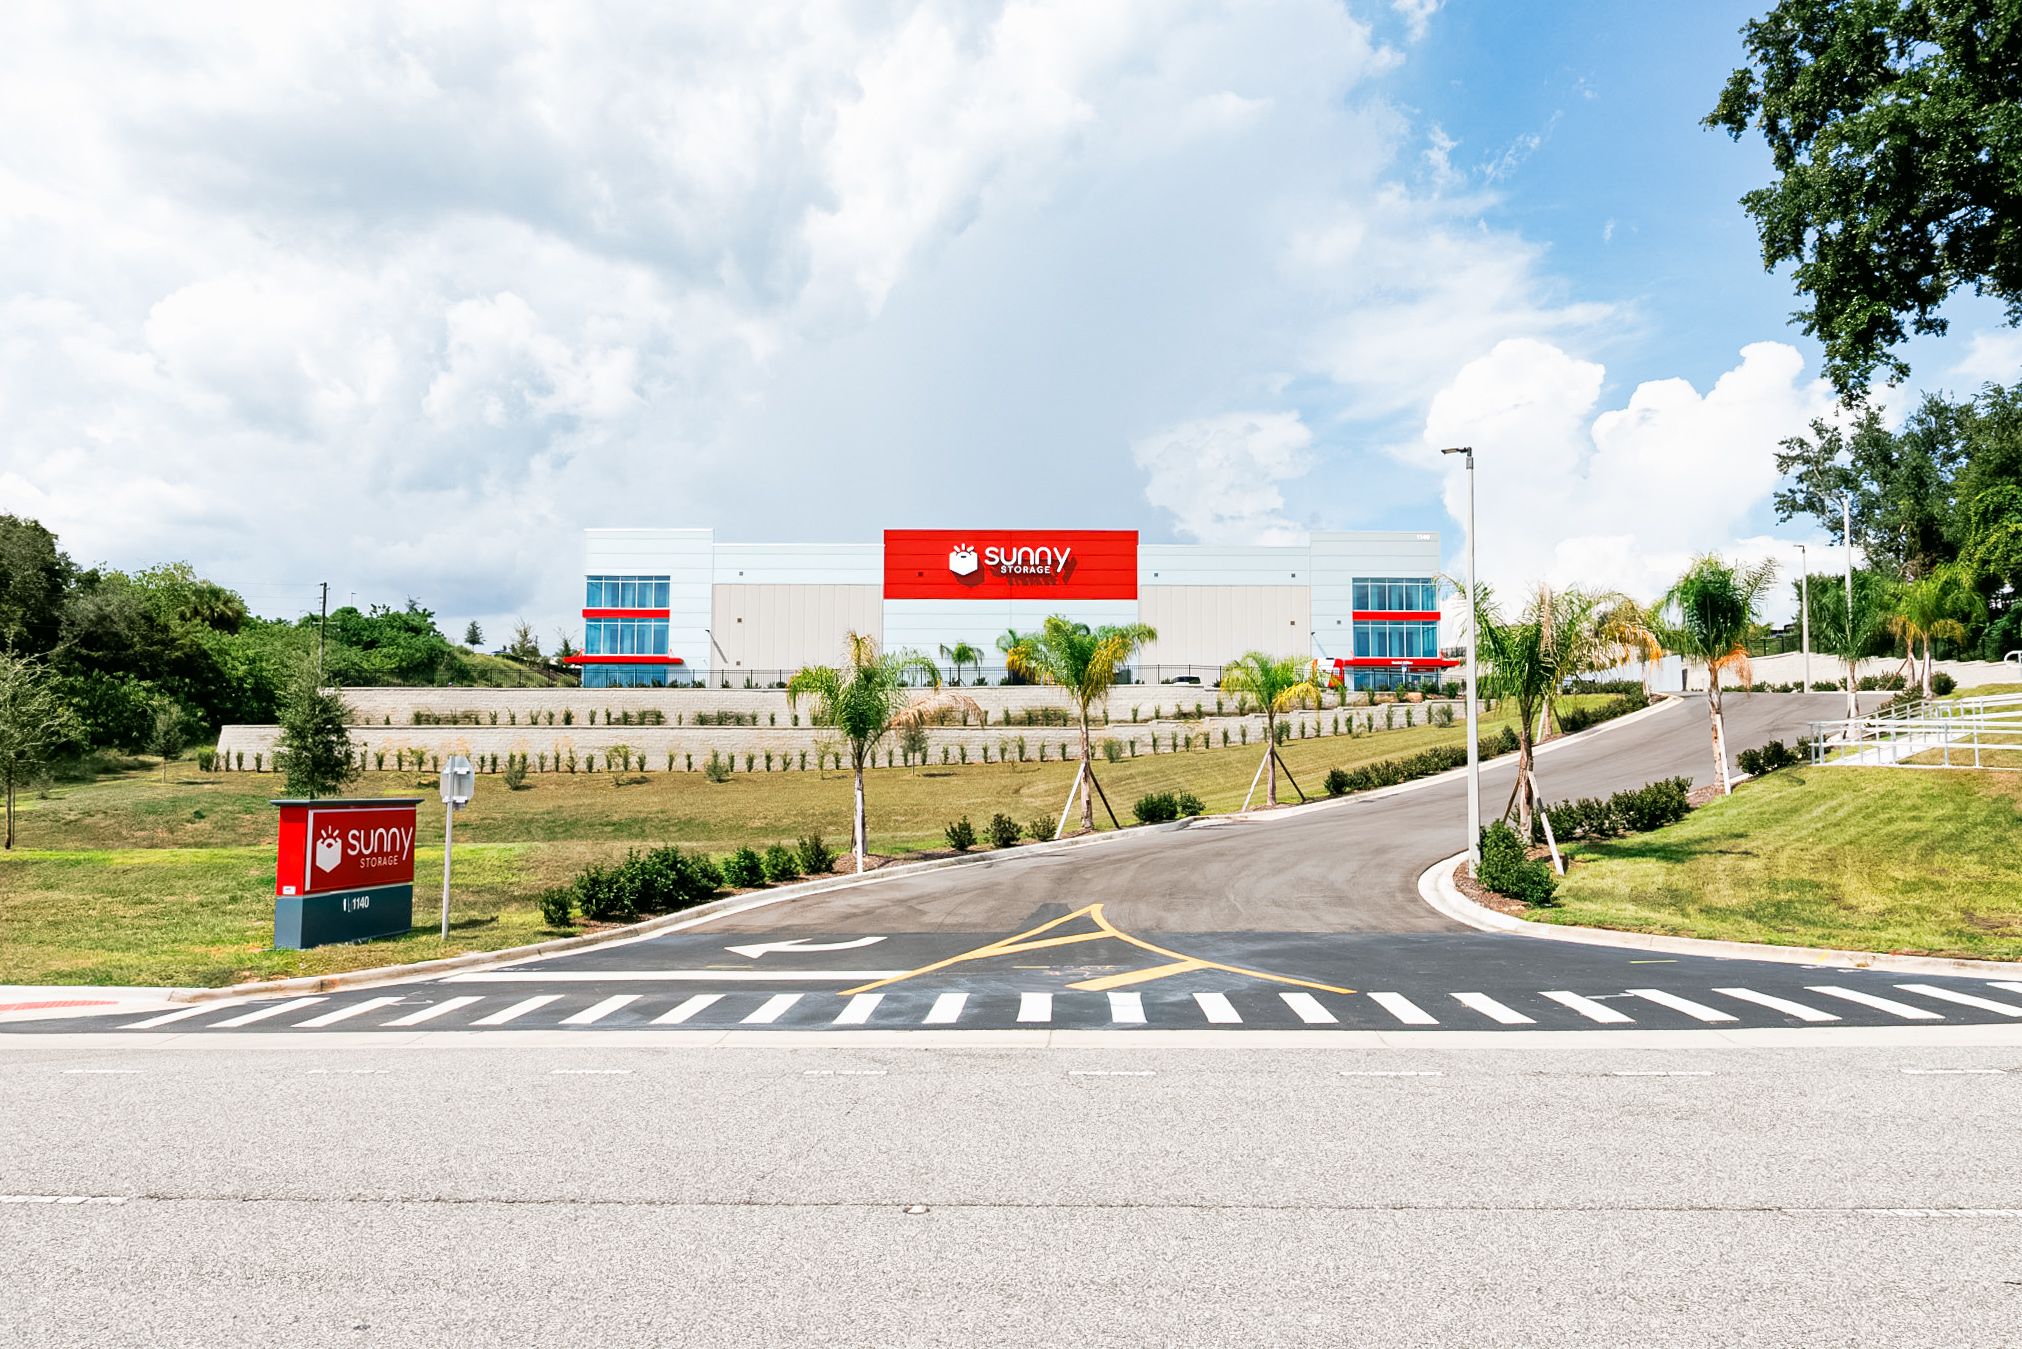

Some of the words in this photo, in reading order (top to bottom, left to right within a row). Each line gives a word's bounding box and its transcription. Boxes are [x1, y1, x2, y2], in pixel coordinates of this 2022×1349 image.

[1000, 565, 1051, 574] STORAGE
[360, 855, 399, 869] STORAGE
[352, 895, 370, 910] 1140
